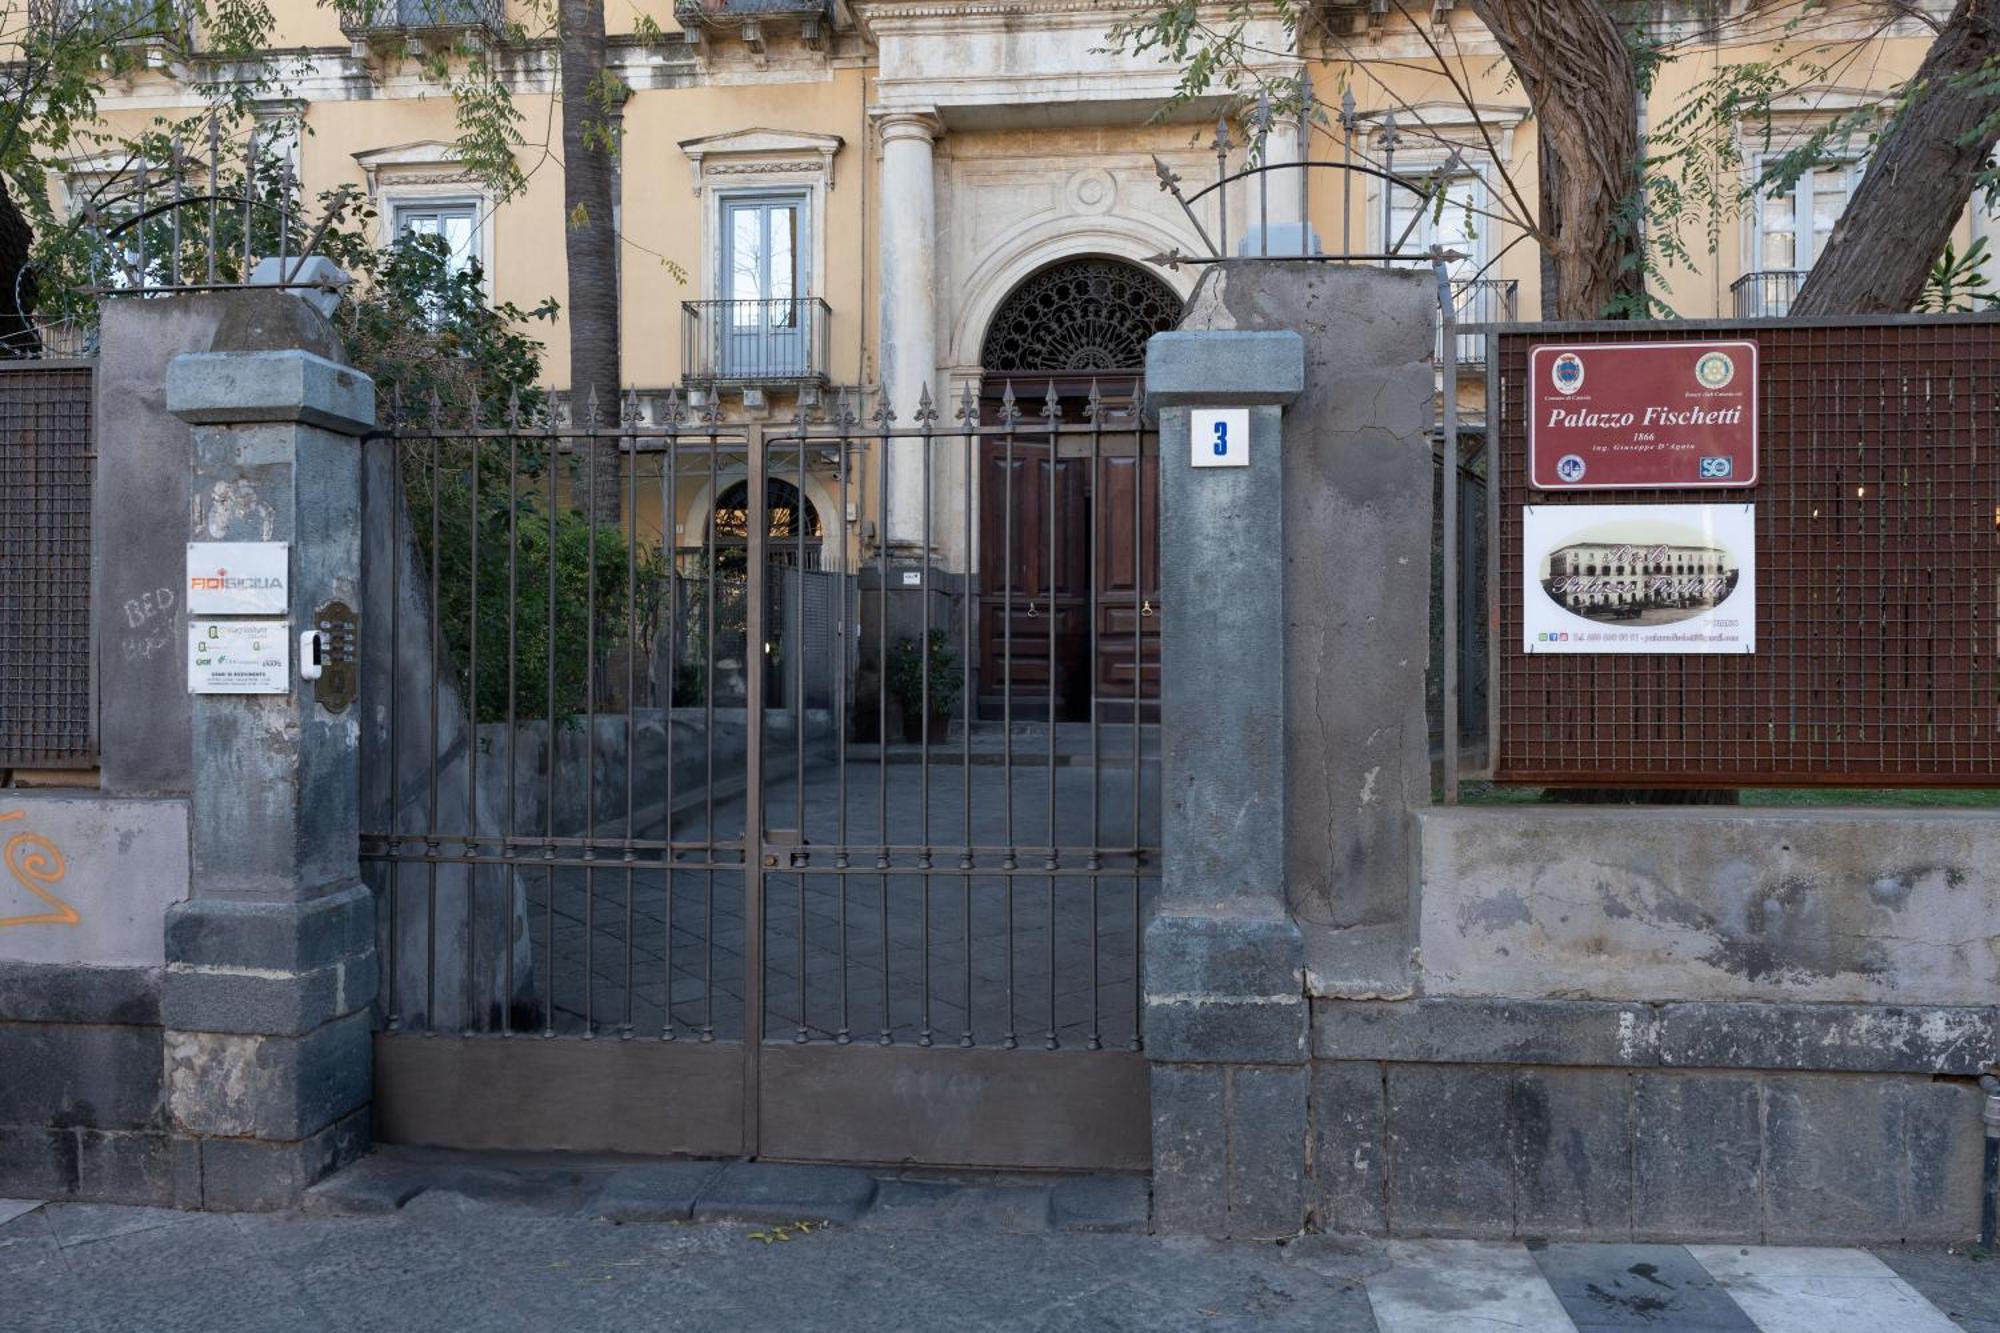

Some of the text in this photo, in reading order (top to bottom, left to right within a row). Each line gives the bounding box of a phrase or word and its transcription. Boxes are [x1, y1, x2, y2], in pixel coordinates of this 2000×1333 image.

[1548, 405, 1742, 428] Palazzo Fischetti
[1214, 421, 1227, 456] 3
[1633, 432, 1656, 442] 1866
[1551, 575, 1637, 595] Palazzo
